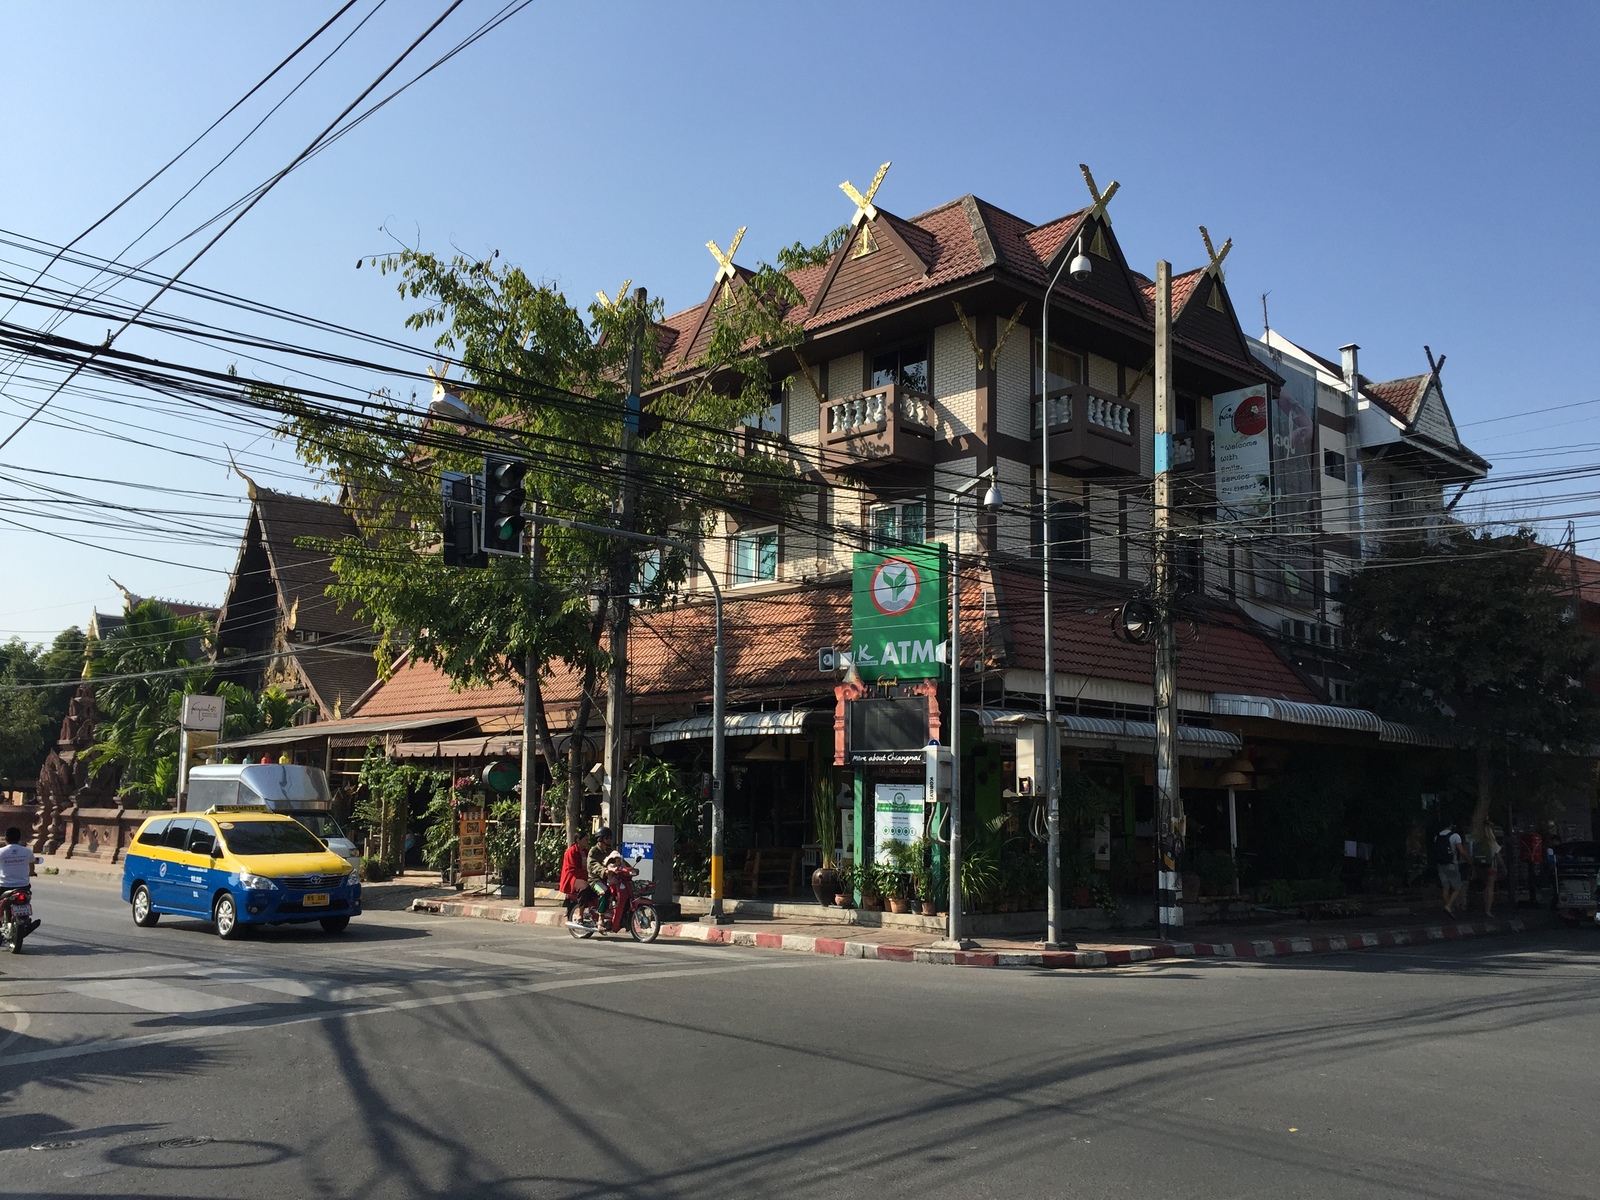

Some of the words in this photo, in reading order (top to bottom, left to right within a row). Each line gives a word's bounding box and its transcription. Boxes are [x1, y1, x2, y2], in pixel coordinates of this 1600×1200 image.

[880, 639, 935, 665] ATM
[868, 753, 887, 762] about
[887, 752, 922, 765] Chiangmai
